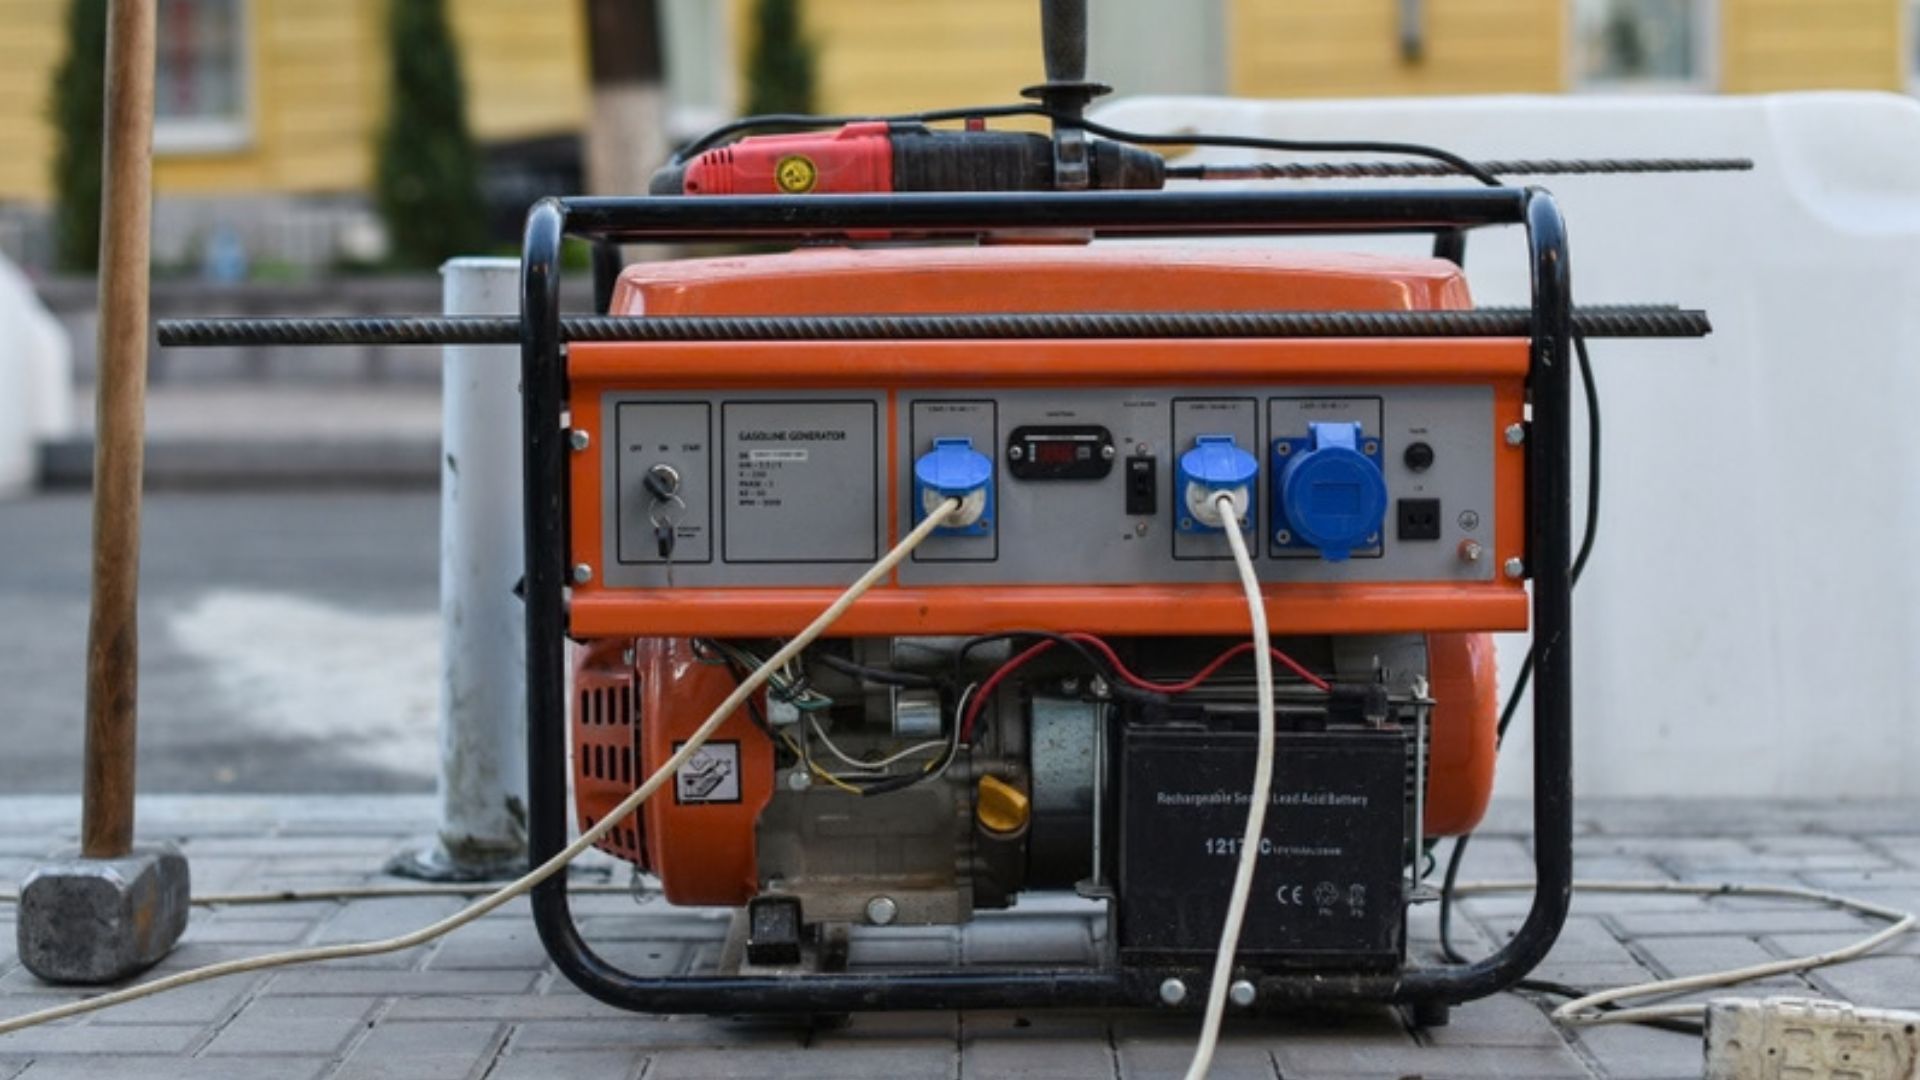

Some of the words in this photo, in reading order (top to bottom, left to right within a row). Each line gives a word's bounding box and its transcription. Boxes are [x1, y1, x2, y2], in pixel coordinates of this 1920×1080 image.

[739, 431, 786, 441] GASOLINE
[789, 431, 846, 441] GENERATOR
[1157, 791, 1231, 807] Rechargeable
[1273, 792, 1300, 805] Lead
[1302, 792, 1326, 805] Acid
[1327, 792, 1368, 808] Battery
